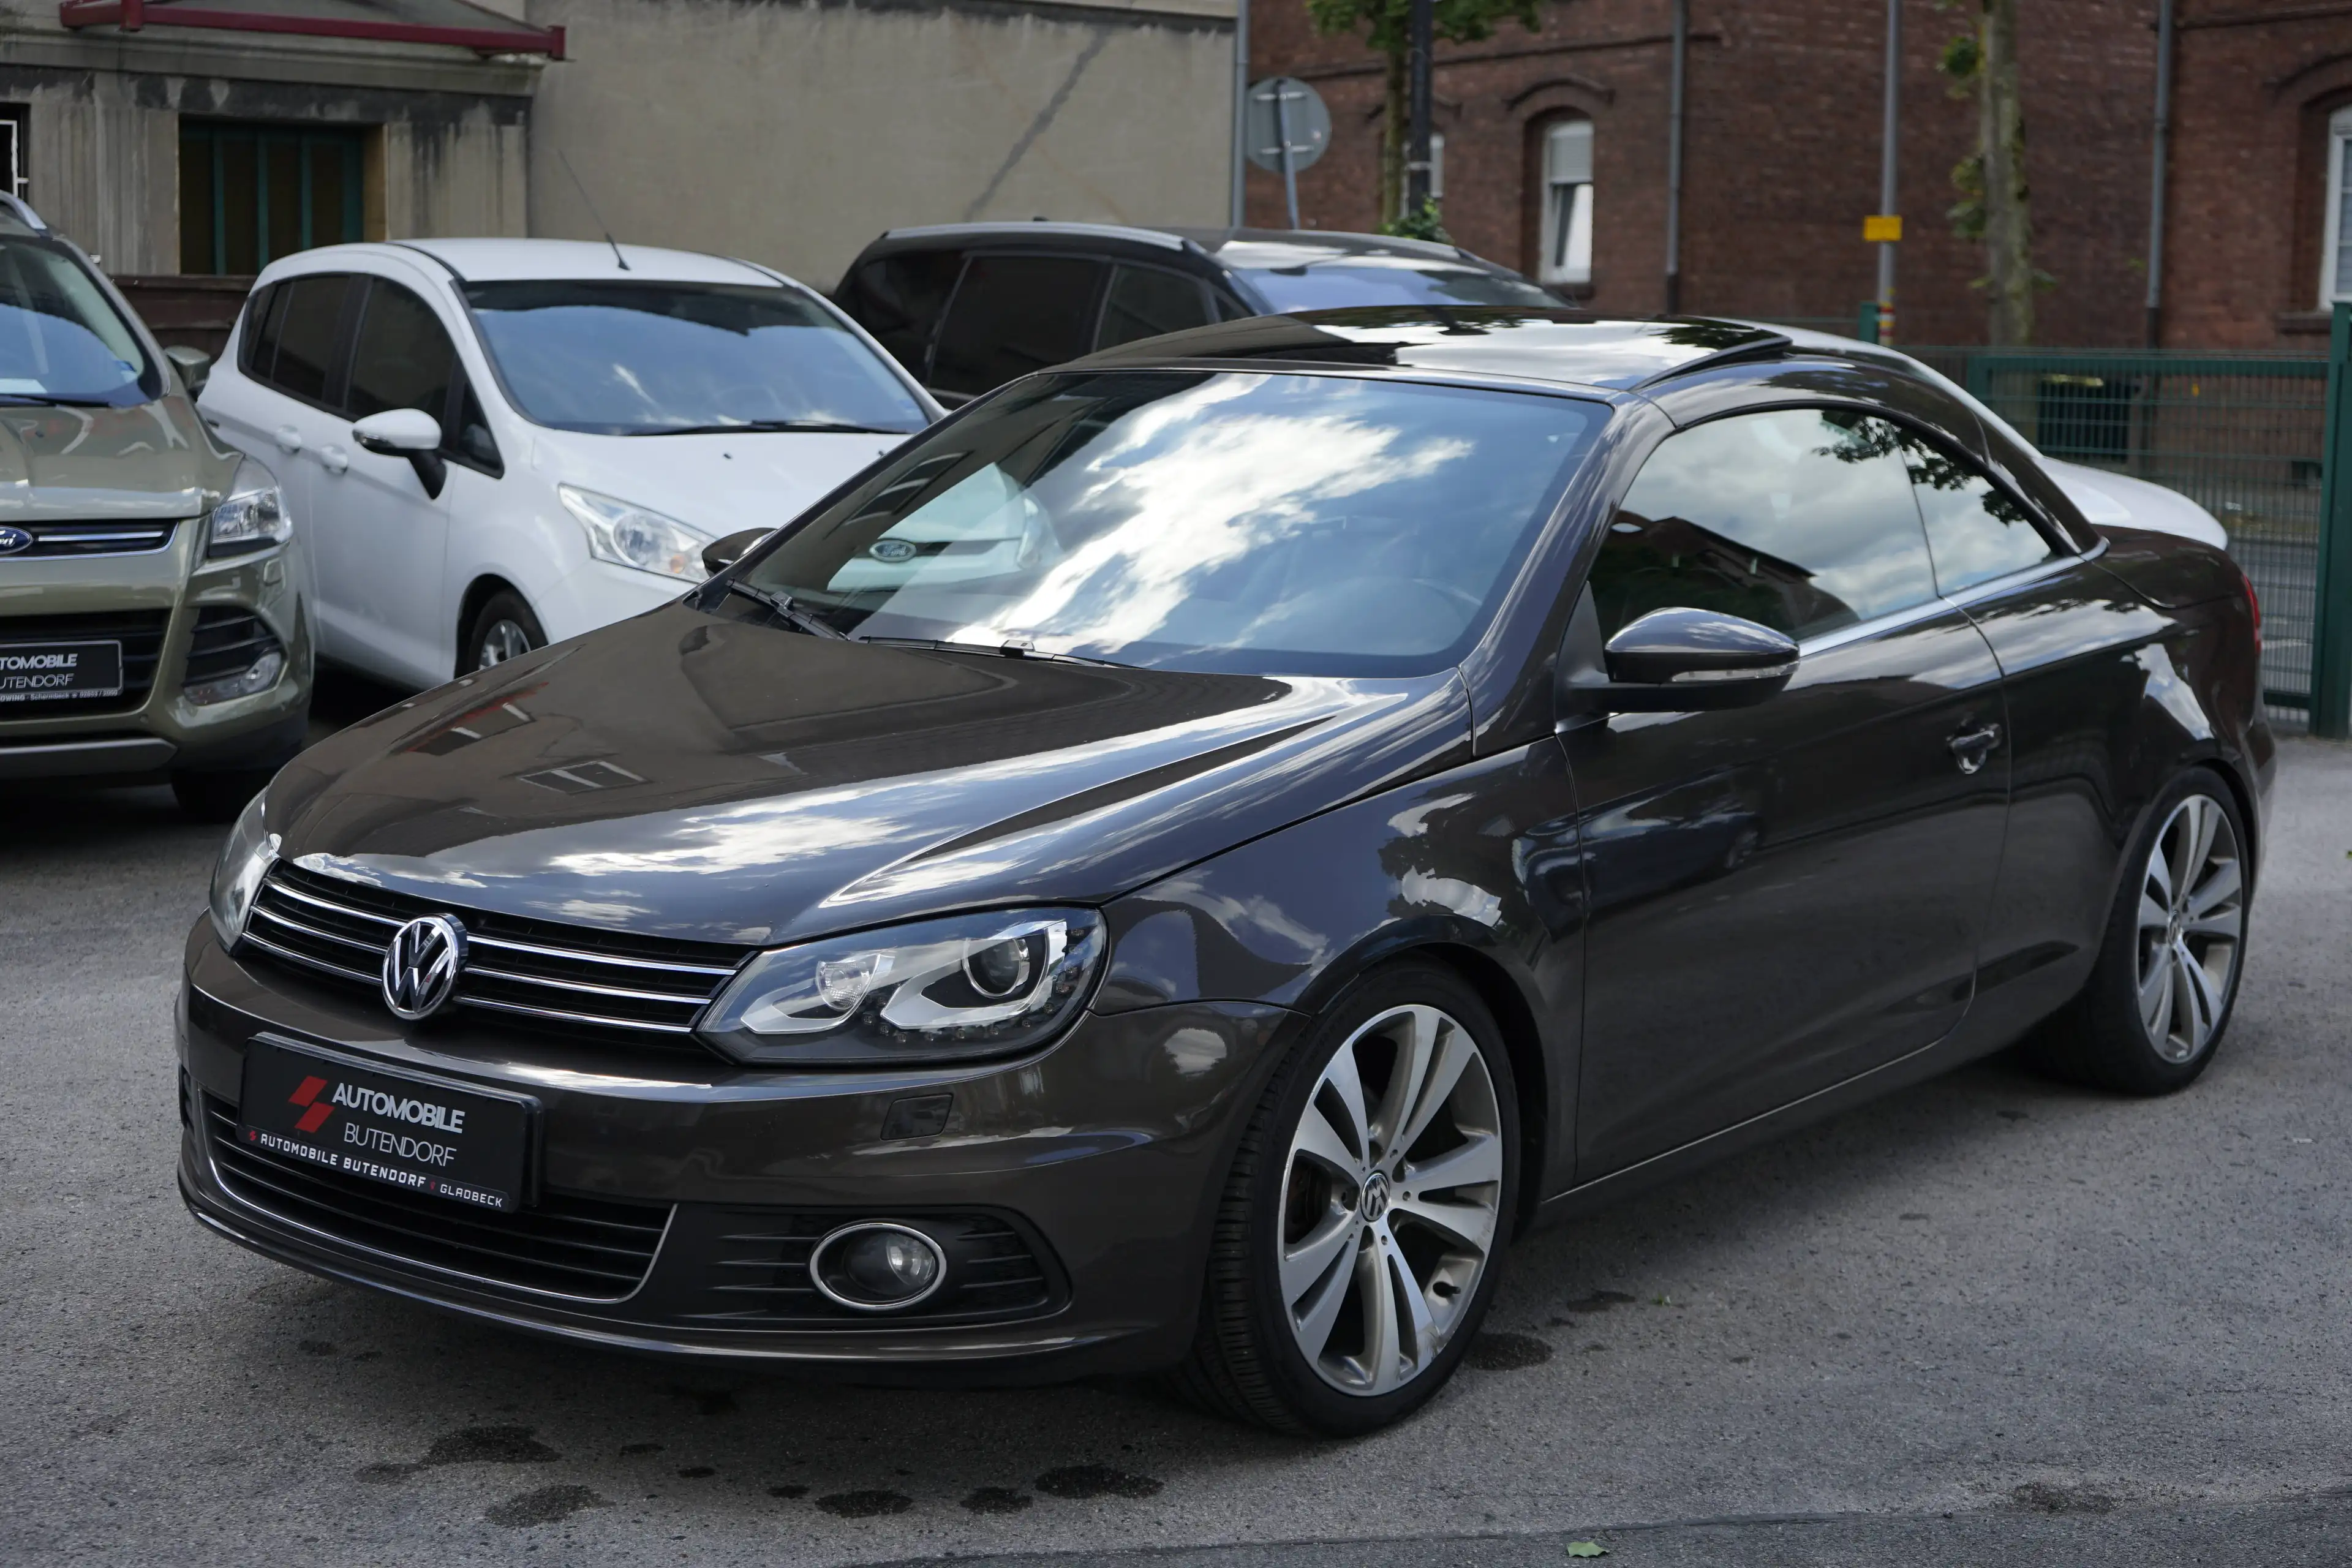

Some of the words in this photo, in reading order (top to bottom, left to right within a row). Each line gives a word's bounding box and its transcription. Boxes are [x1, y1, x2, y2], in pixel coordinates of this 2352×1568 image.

[331, 1082, 466, 1134] AUTOMOBILE
[260, 1133, 338, 1166] AUTOMOBILE
[343, 1157, 426, 1188] BUTENDORF
[440, 1184, 503, 1208] GLADBECK
[344, 1122, 457, 1167] BUTENDORF
